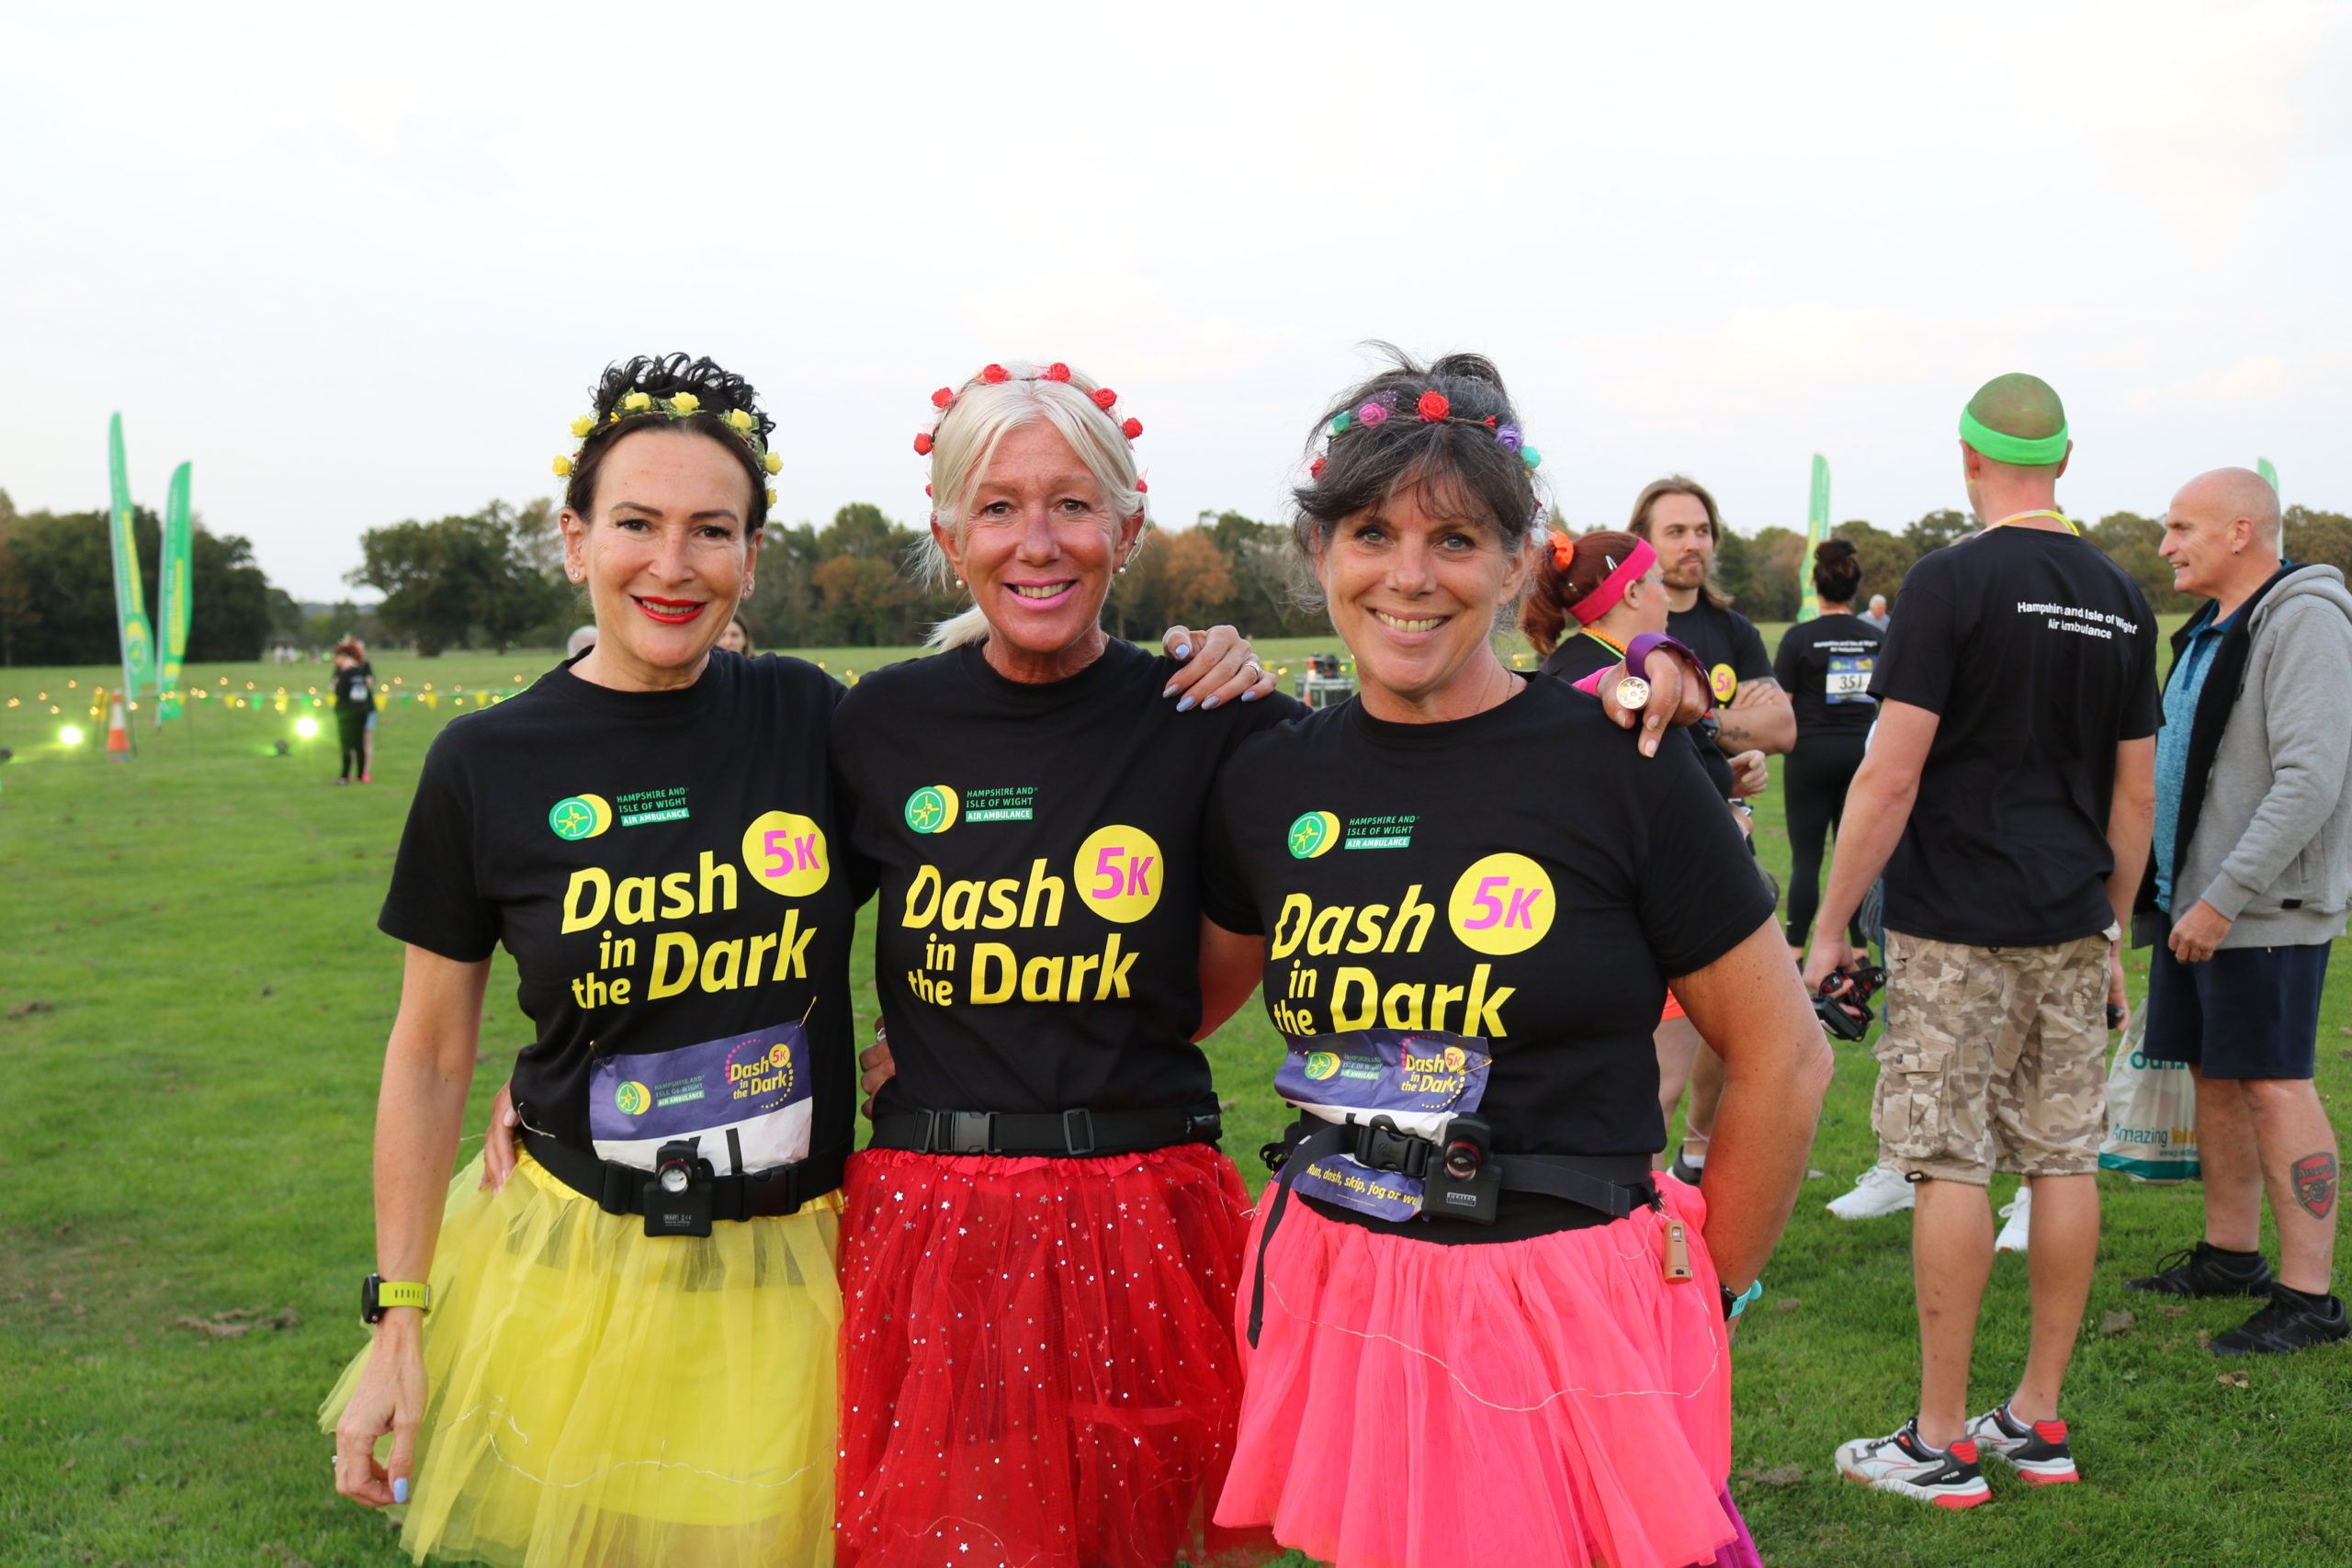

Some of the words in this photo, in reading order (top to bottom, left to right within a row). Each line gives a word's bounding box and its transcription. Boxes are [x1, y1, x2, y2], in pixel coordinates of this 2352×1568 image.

[2047, 618, 2060, 629] Air
[2064, 607, 2084, 618] and
[2085, 609, 2104, 622] Isle
[2105, 615, 2115, 625] of
[2115, 615, 2138, 635] Wight
[1839, 674, 1862, 691] 351
[616, 790, 666, 803] HAMPSHIRE
[669, 787, 685, 796] AND
[967, 787, 1013, 797] HAMPSHIRE
[618, 804, 639, 813] ISLE
[641, 802, 653, 810] OF
[656, 797, 686, 808] WIGHT
[967, 799, 985, 808] ISLE
[989, 798, 1000, 807] OF
[1003, 797, 1033, 807] WIGHT
[623, 817, 638, 825] AIR
[639, 810, 686, 822] AMBULANCE
[967, 812, 981, 820] AIR
[984, 810, 1030, 819] AMBULANCE
[1350, 817, 1396, 826] HAMPSHIRE
[1347, 828, 1366, 836] ISLE
[1369, 827, 1381, 835] OF
[1384, 826, 1414, 834] WIGHT
[1362, 838, 1408, 847] AMBULANCE
[763, 829, 820, 878] 5K
[1091, 847, 1155, 899] 5K
[561, 851, 738, 934] Dash
[901, 858, 1065, 931] Dash
[1463, 876, 1544, 930] 5K
[1271, 884, 1435, 961] Dash
[571, 972, 631, 1009] the
[647, 908, 818, 1000] Dark
[600, 930, 636, 970] in
[925, 933, 956, 972] in
[908, 968, 953, 1007] the
[970, 933, 1139, 1005] Dark
[1288, 959, 1317, 998] in
[1273, 999, 1317, 1036] the
[1330, 964, 1516, 1037] Dark
[773, 1049, 786, 1064] 5K
[1405, 1054, 1444, 1073] Dash
[1446, 1053, 1460, 1066] 5K
[730, 1056, 769, 1081] Dash
[1410, 1072, 1420, 1082] in
[654, 1078, 688, 1090] HAMPSHIRE
[656, 1089, 669, 1098] ISLE
[682, 1083, 703, 1093] WIGHT
[733, 1089, 748, 1100] the
[751, 1071, 787, 1095] Dark
[741, 1079, 748, 1090] in
[1401, 1081, 1417, 1091] the
[1419, 1075, 1458, 1093] Dark
[670, 1092, 703, 1103] AMBULANCE
[2113, 1122, 2167, 1148] Amazing
[1306, 1163, 1321, 1178] Run,
[1323, 1168, 1342, 1185] dash,
[1343, 1176, 1365, 1193] skip,
[1367, 1181, 1386, 1201] jog
[1387, 1189, 1401, 1201] or
